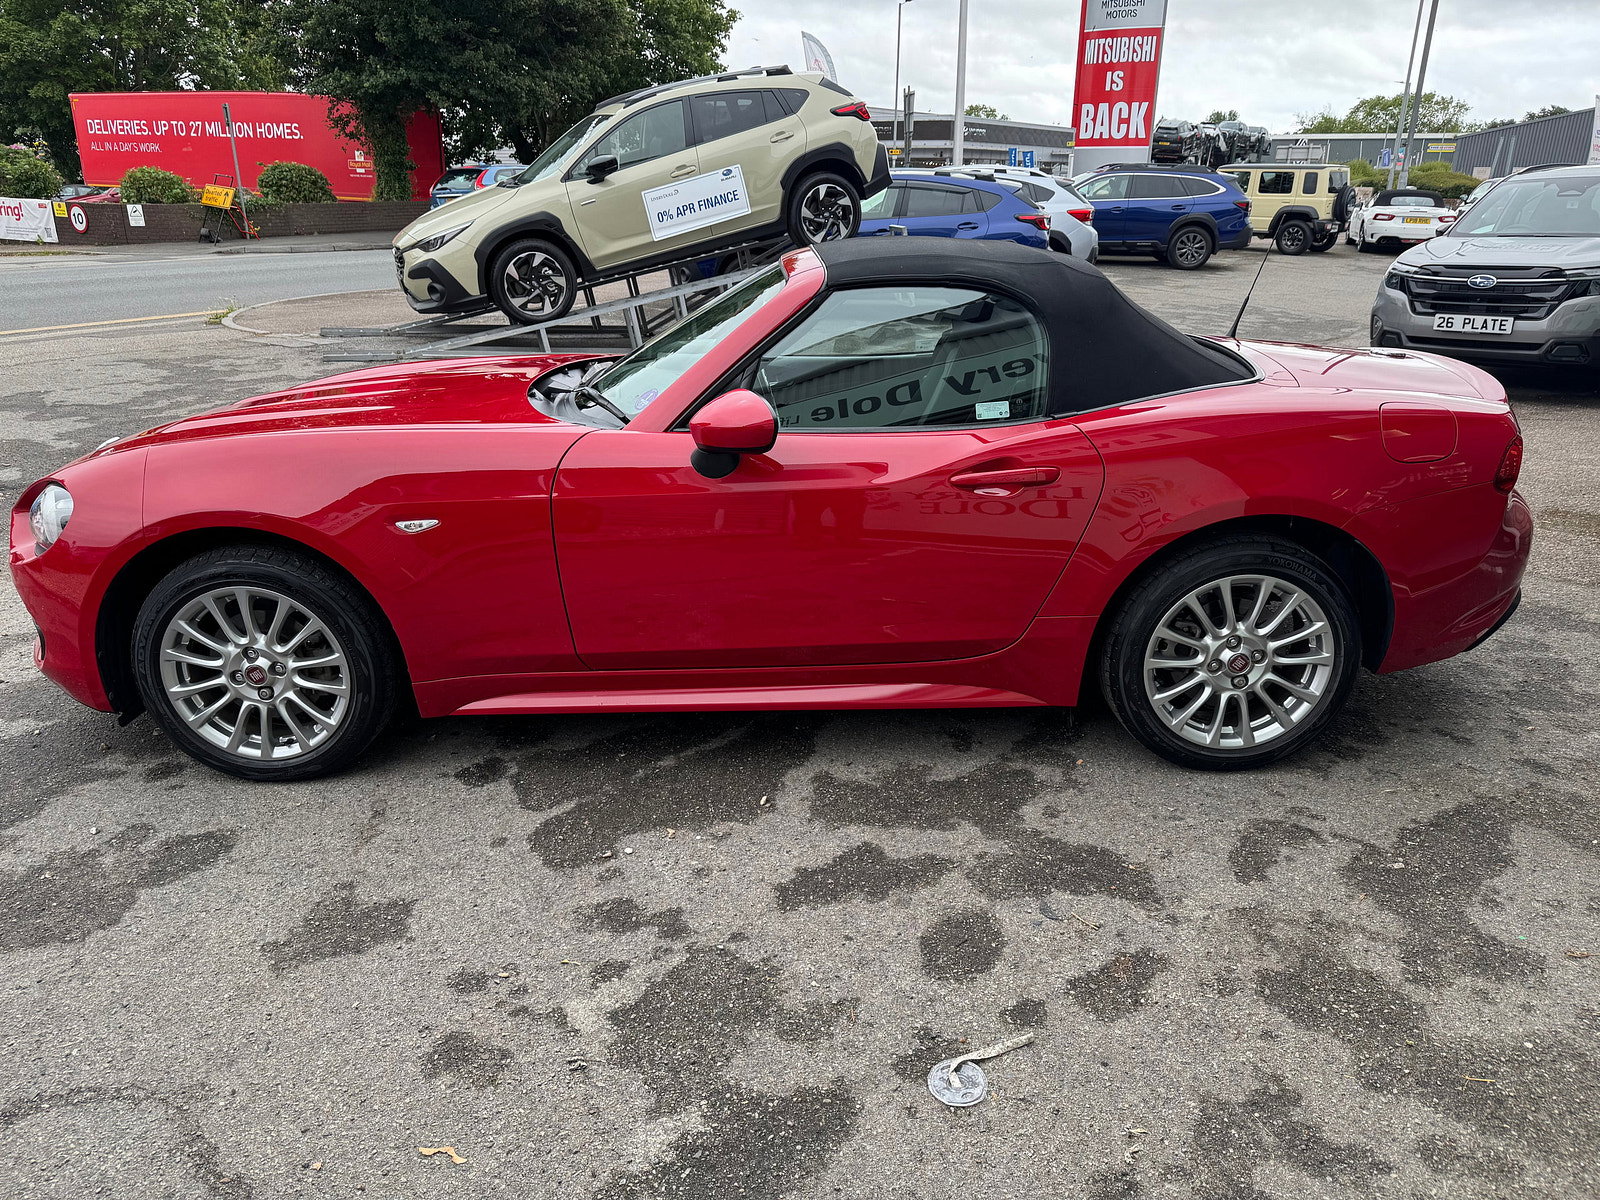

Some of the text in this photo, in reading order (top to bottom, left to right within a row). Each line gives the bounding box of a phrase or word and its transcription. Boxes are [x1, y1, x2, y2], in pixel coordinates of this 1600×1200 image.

[1101, 0, 1145, 9] MITSUBISHI
[1106, 9, 1137, 19] MOTORS
[1085, 36, 1157, 64] MITSUBISHI
[1105, 71, 1124, 91] IS
[86, 120, 304, 139] DELIVERIES. UP TO 27 MILLION HOMES.
[1079, 102, 1149, 139] BACK
[91, 141, 162, 153] ALL IN A DAY'S WORK.
[657, 189, 740, 223] 0% APR FINANCE
[72, 212, 84, 225] 10
[1436, 316, 1509, 331] 26 PLATE
[1268, 556, 1318, 581] YOKOHAMA
